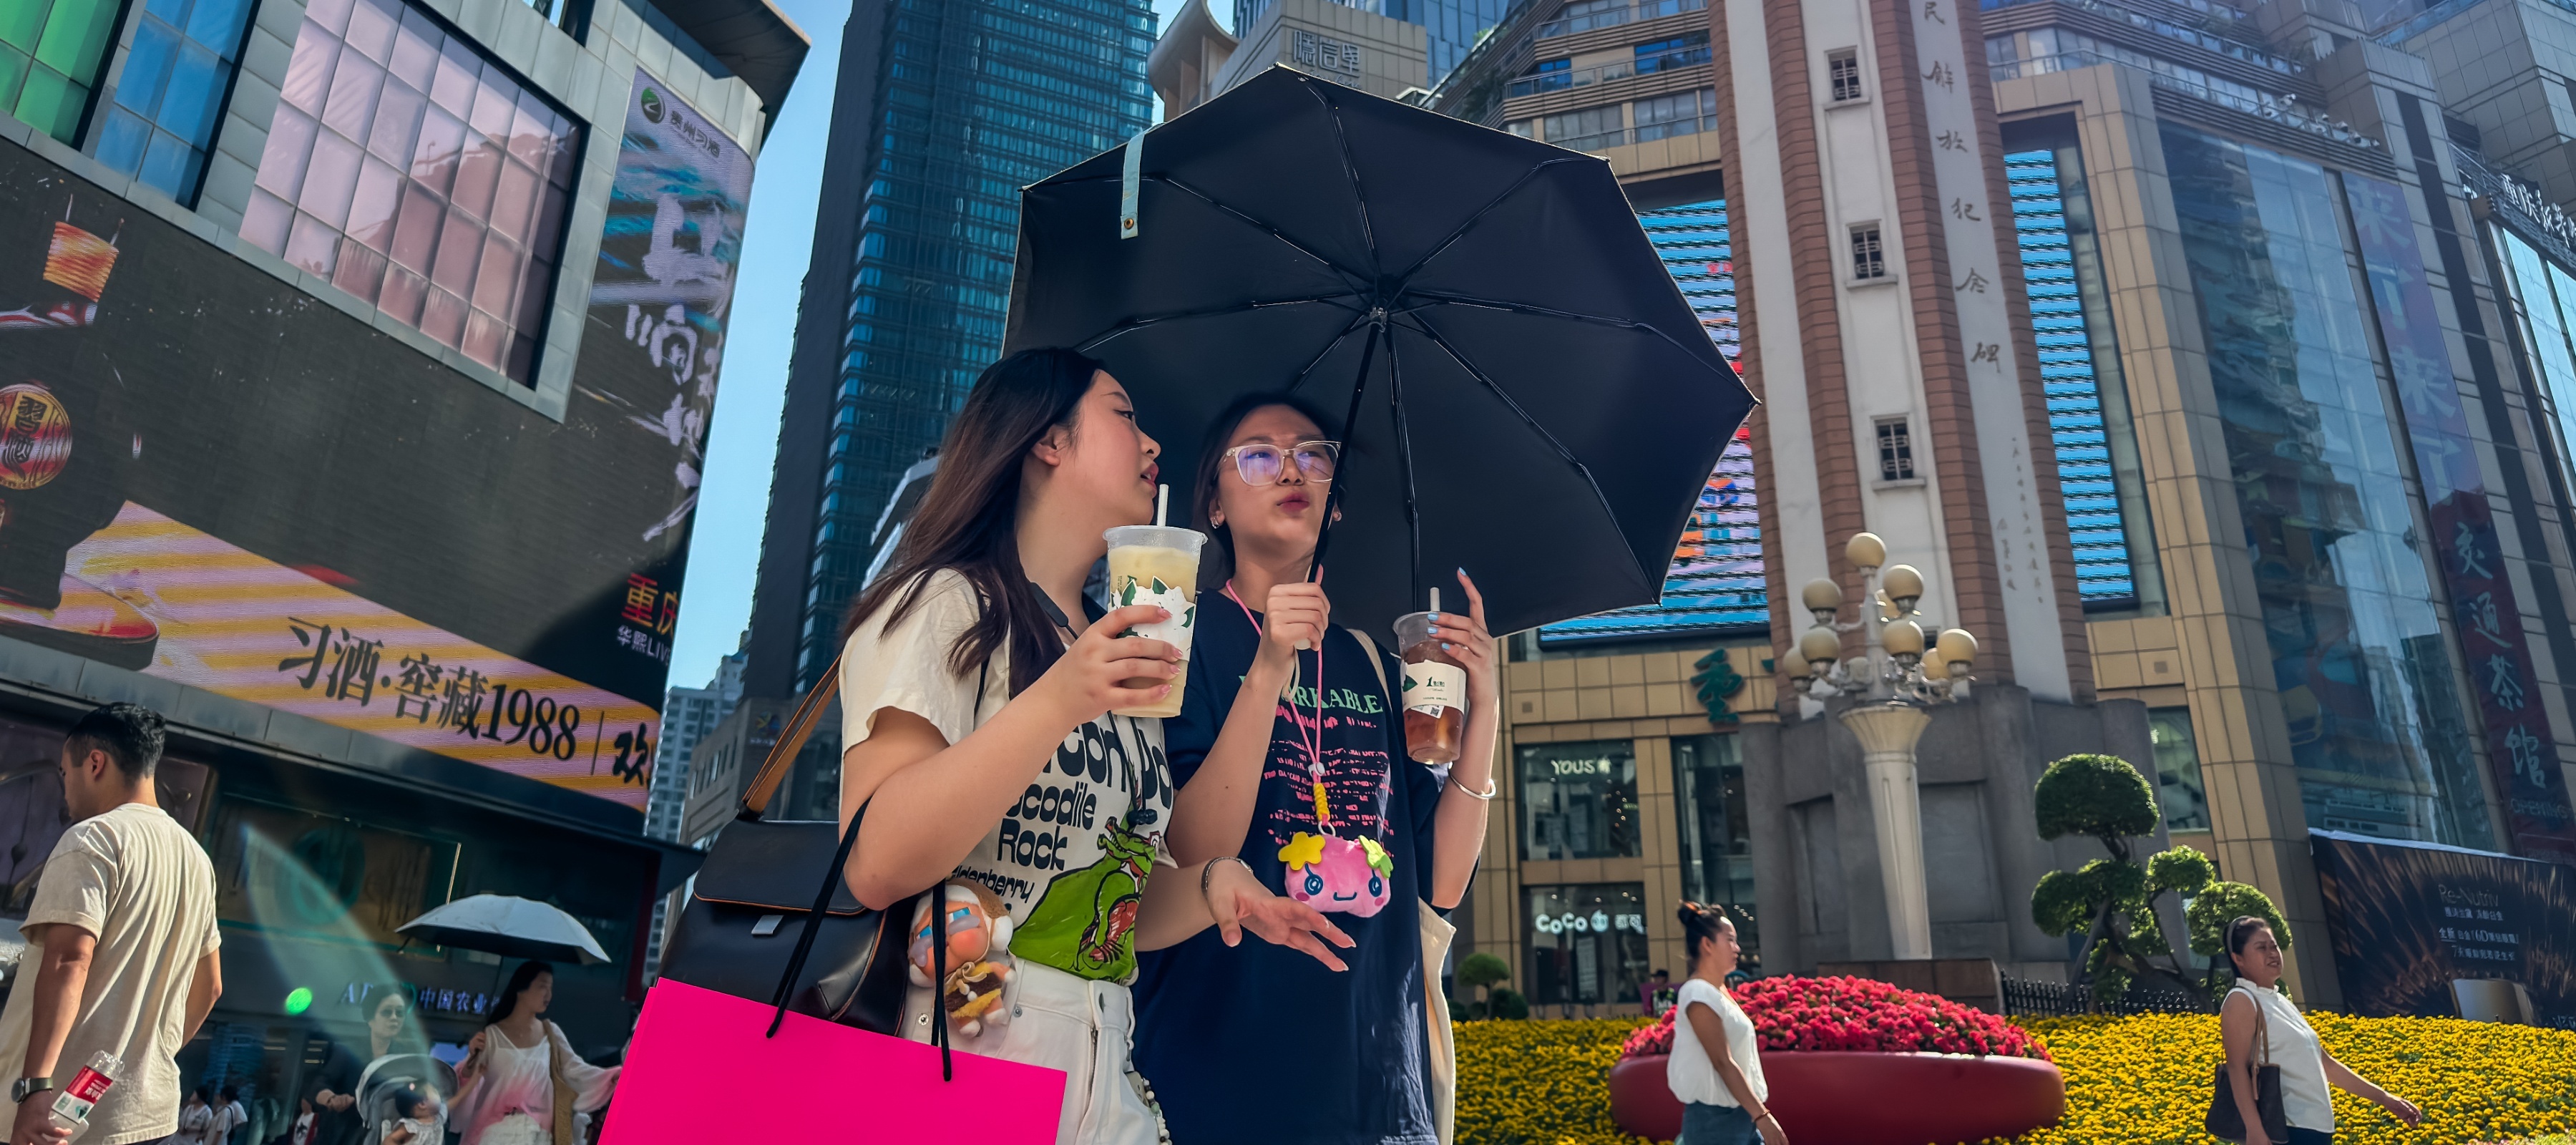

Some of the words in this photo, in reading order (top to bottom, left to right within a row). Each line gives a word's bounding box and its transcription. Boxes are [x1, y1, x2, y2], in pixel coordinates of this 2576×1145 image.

[621, 572, 679, 640] 重庆
[613, 721, 654, 790] 欢
[997, 817, 1068, 871] Rock
[1536, 912, 1589, 934] CoCo
